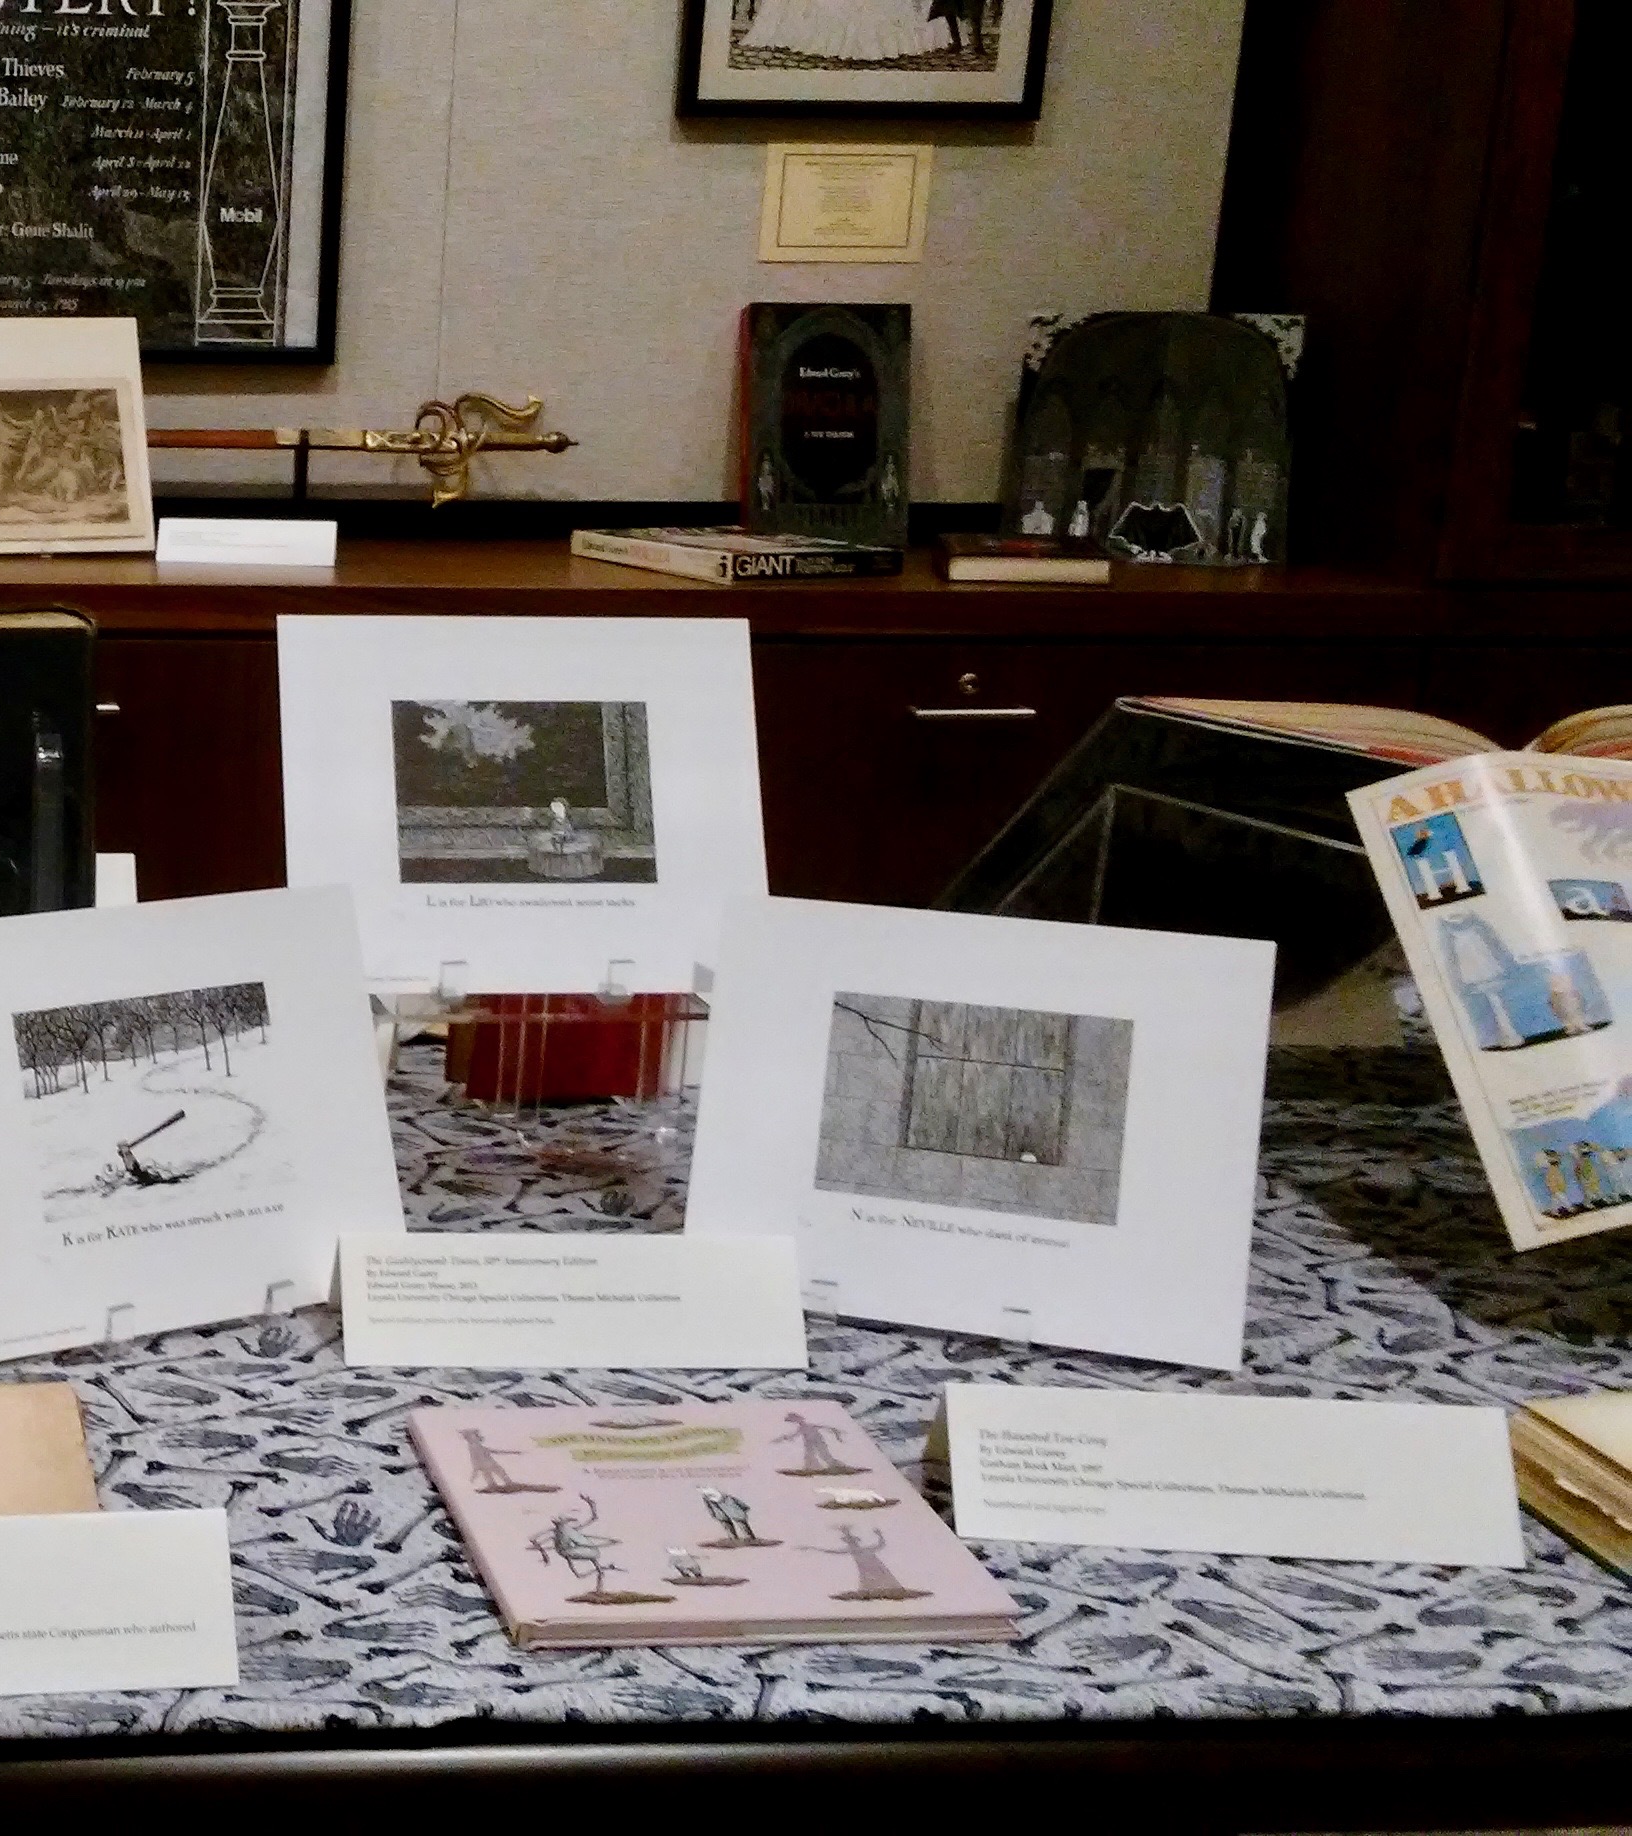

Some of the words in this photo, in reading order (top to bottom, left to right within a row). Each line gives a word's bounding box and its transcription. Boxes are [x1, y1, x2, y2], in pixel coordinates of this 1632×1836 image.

[82, 23, 150, 38] criminal
[2, 57, 65, 79] Thieves
[126, 66, 183, 85] February
[219, 207, 263, 223] Mobil
[11, 221, 51, 239] Gene
[52, 221, 95, 240] Shalit
[736, 554, 795, 577] GIANT
[426, 894, 437, 908] L
[851, 1206, 863, 1221] N
[62, 1231, 74, 1247] K
[106, 1224, 139, 1241] KATE
[140, 1222, 164, 1234] who
[186, 1210, 223, 1228] struck
[148, 1619, 197, 1635] authored
